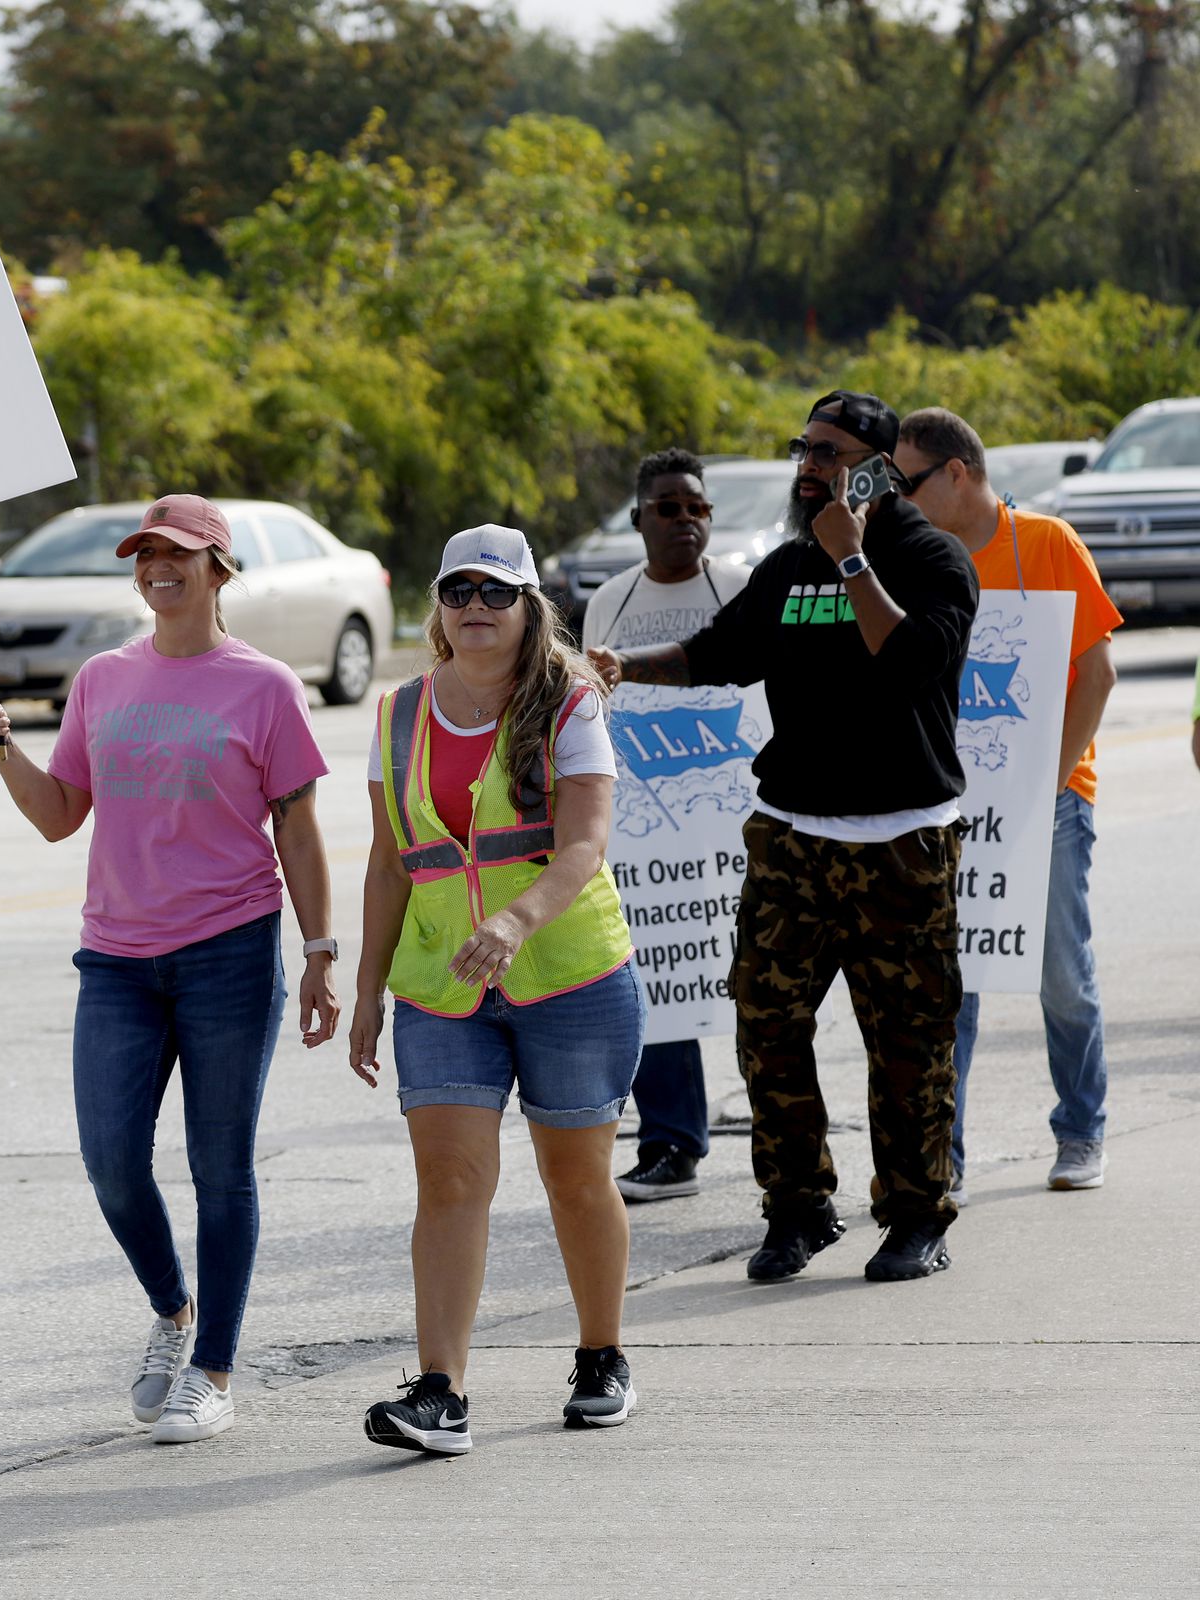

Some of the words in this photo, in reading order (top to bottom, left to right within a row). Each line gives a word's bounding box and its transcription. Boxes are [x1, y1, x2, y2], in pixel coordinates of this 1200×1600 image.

[624, 720, 740, 762] I.L.A.
[648, 858, 706, 884] Over
[989, 872, 1006, 899] a
[636, 935, 721, 973] upport
[646, 974, 729, 1006] Worke
